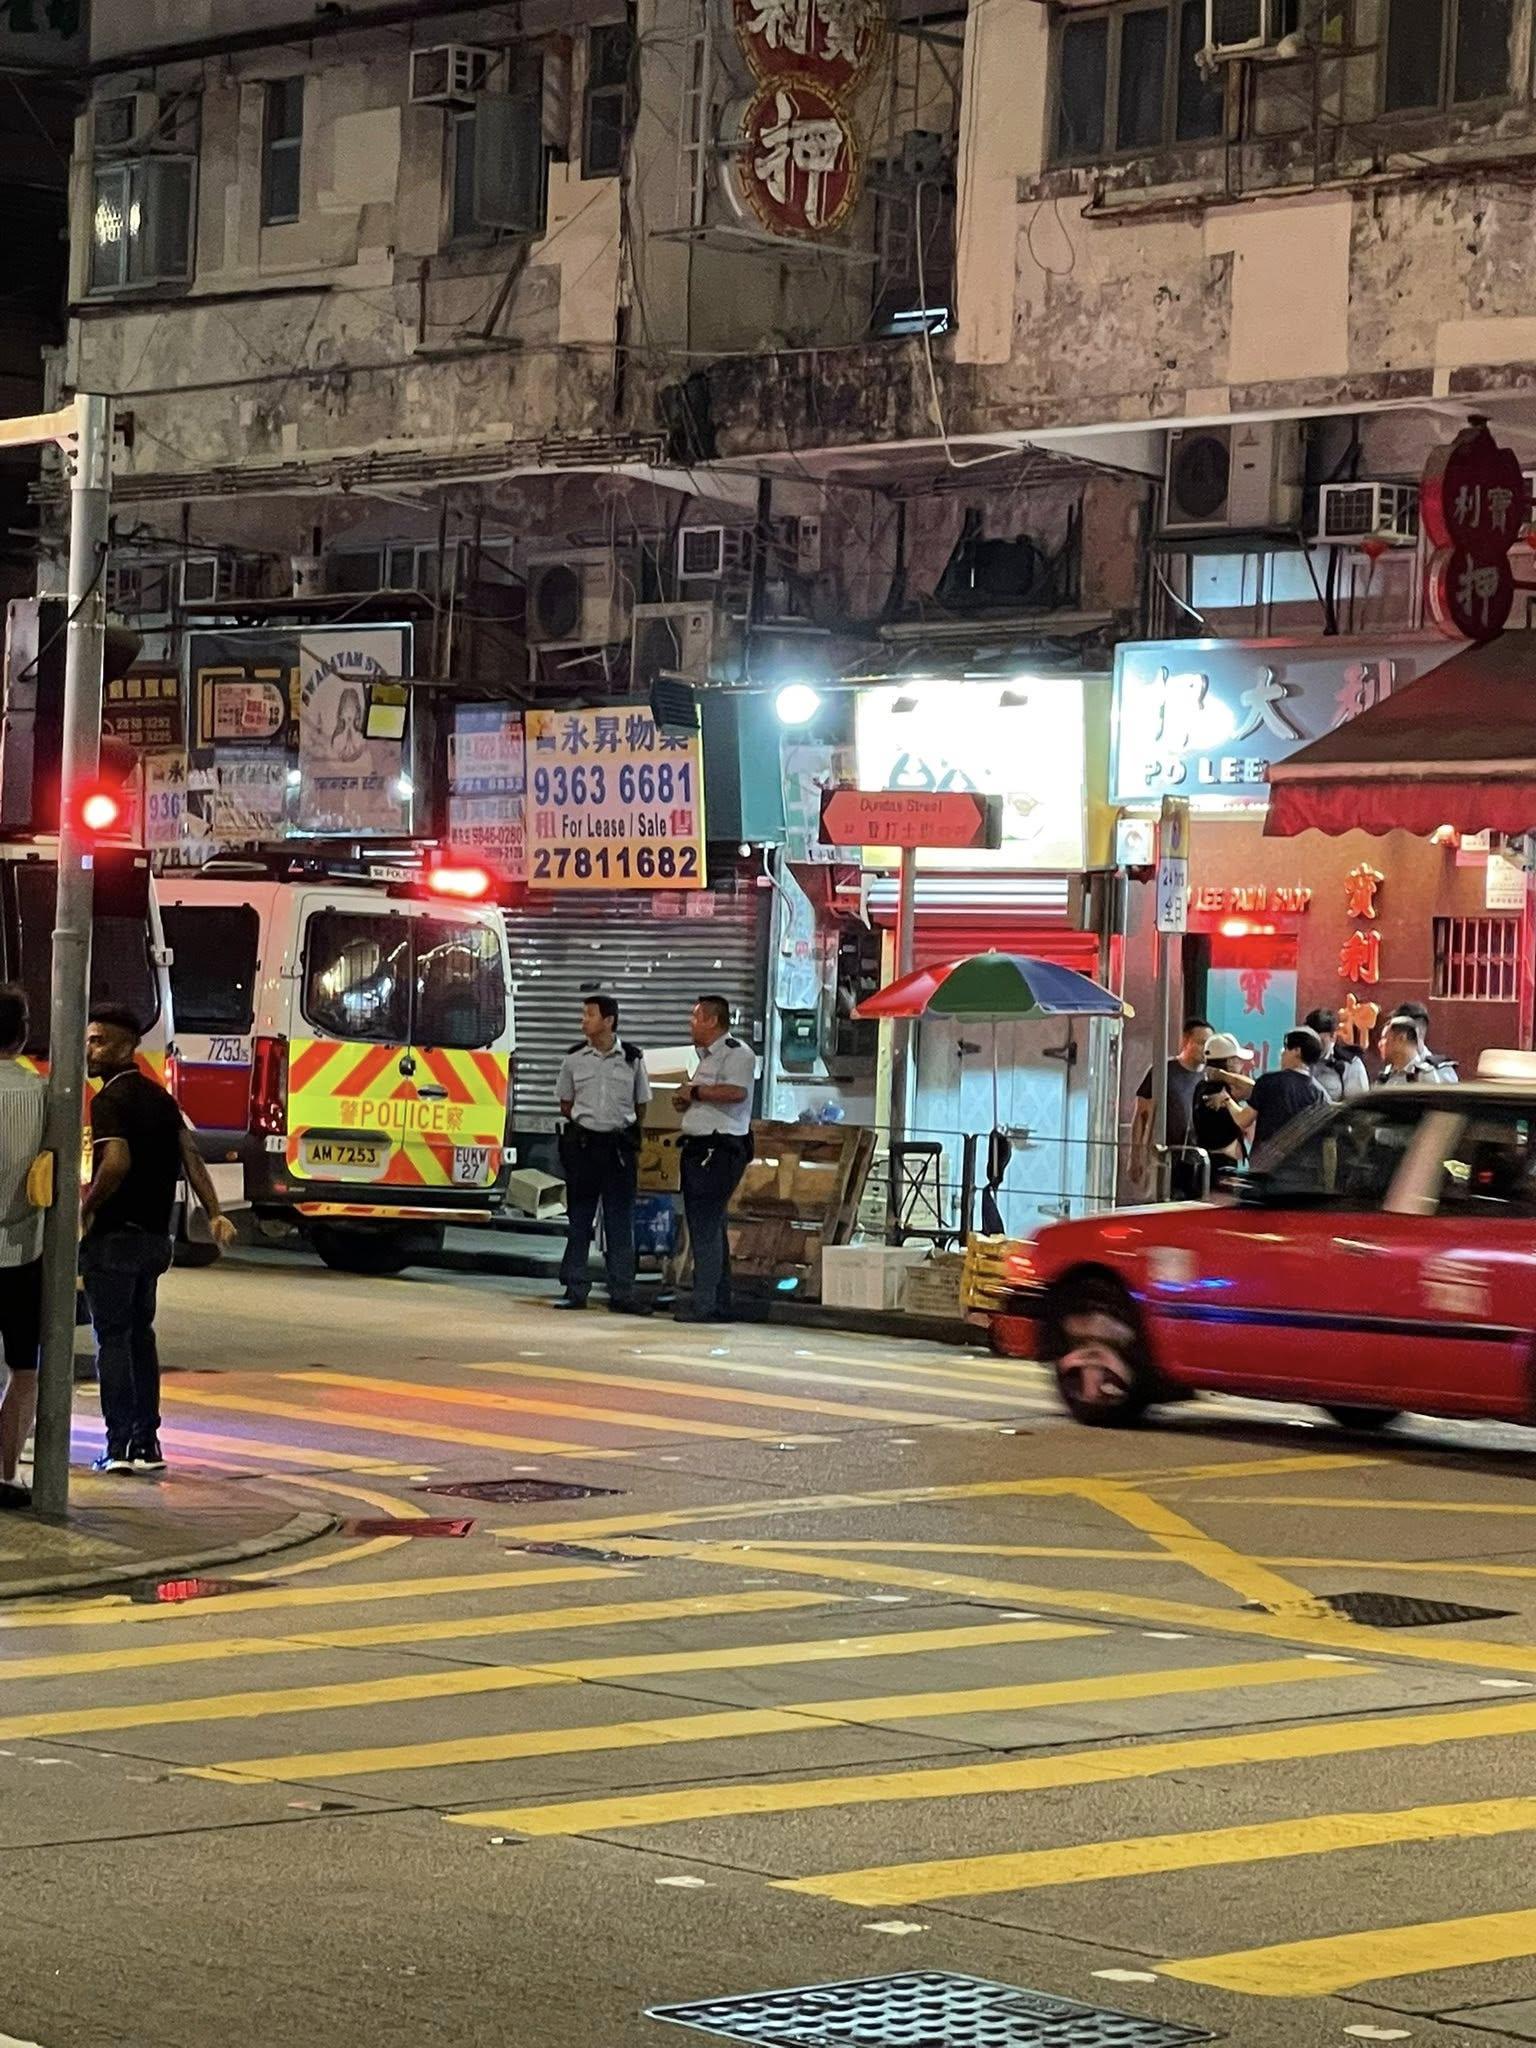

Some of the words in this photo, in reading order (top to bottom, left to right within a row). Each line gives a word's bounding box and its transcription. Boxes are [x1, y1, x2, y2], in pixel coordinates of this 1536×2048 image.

[754, 90, 844, 228] 押
[1456, 552, 1500, 627] 押
[535, 765, 606, 805] 9363
[620, 762, 690, 804] 6681
[1198, 757, 1269, 784] LEE
[536, 811, 557, 838] 租
[562, 814, 582, 838] For
[587, 814, 625, 837] Lease
[638, 813, 667, 837] Sale
[669, 810, 693, 836] 售
[533, 846, 698, 879] 27811682
[208, 1037, 241, 1062] 7253
[361, 1101, 444, 1130] POLICE
[312, 1146, 332, 1161] AM
[336, 1147, 376, 1162] 7253
[456, 1147, 488, 1163] EUKW
[462, 1163, 479, 1179] 27
